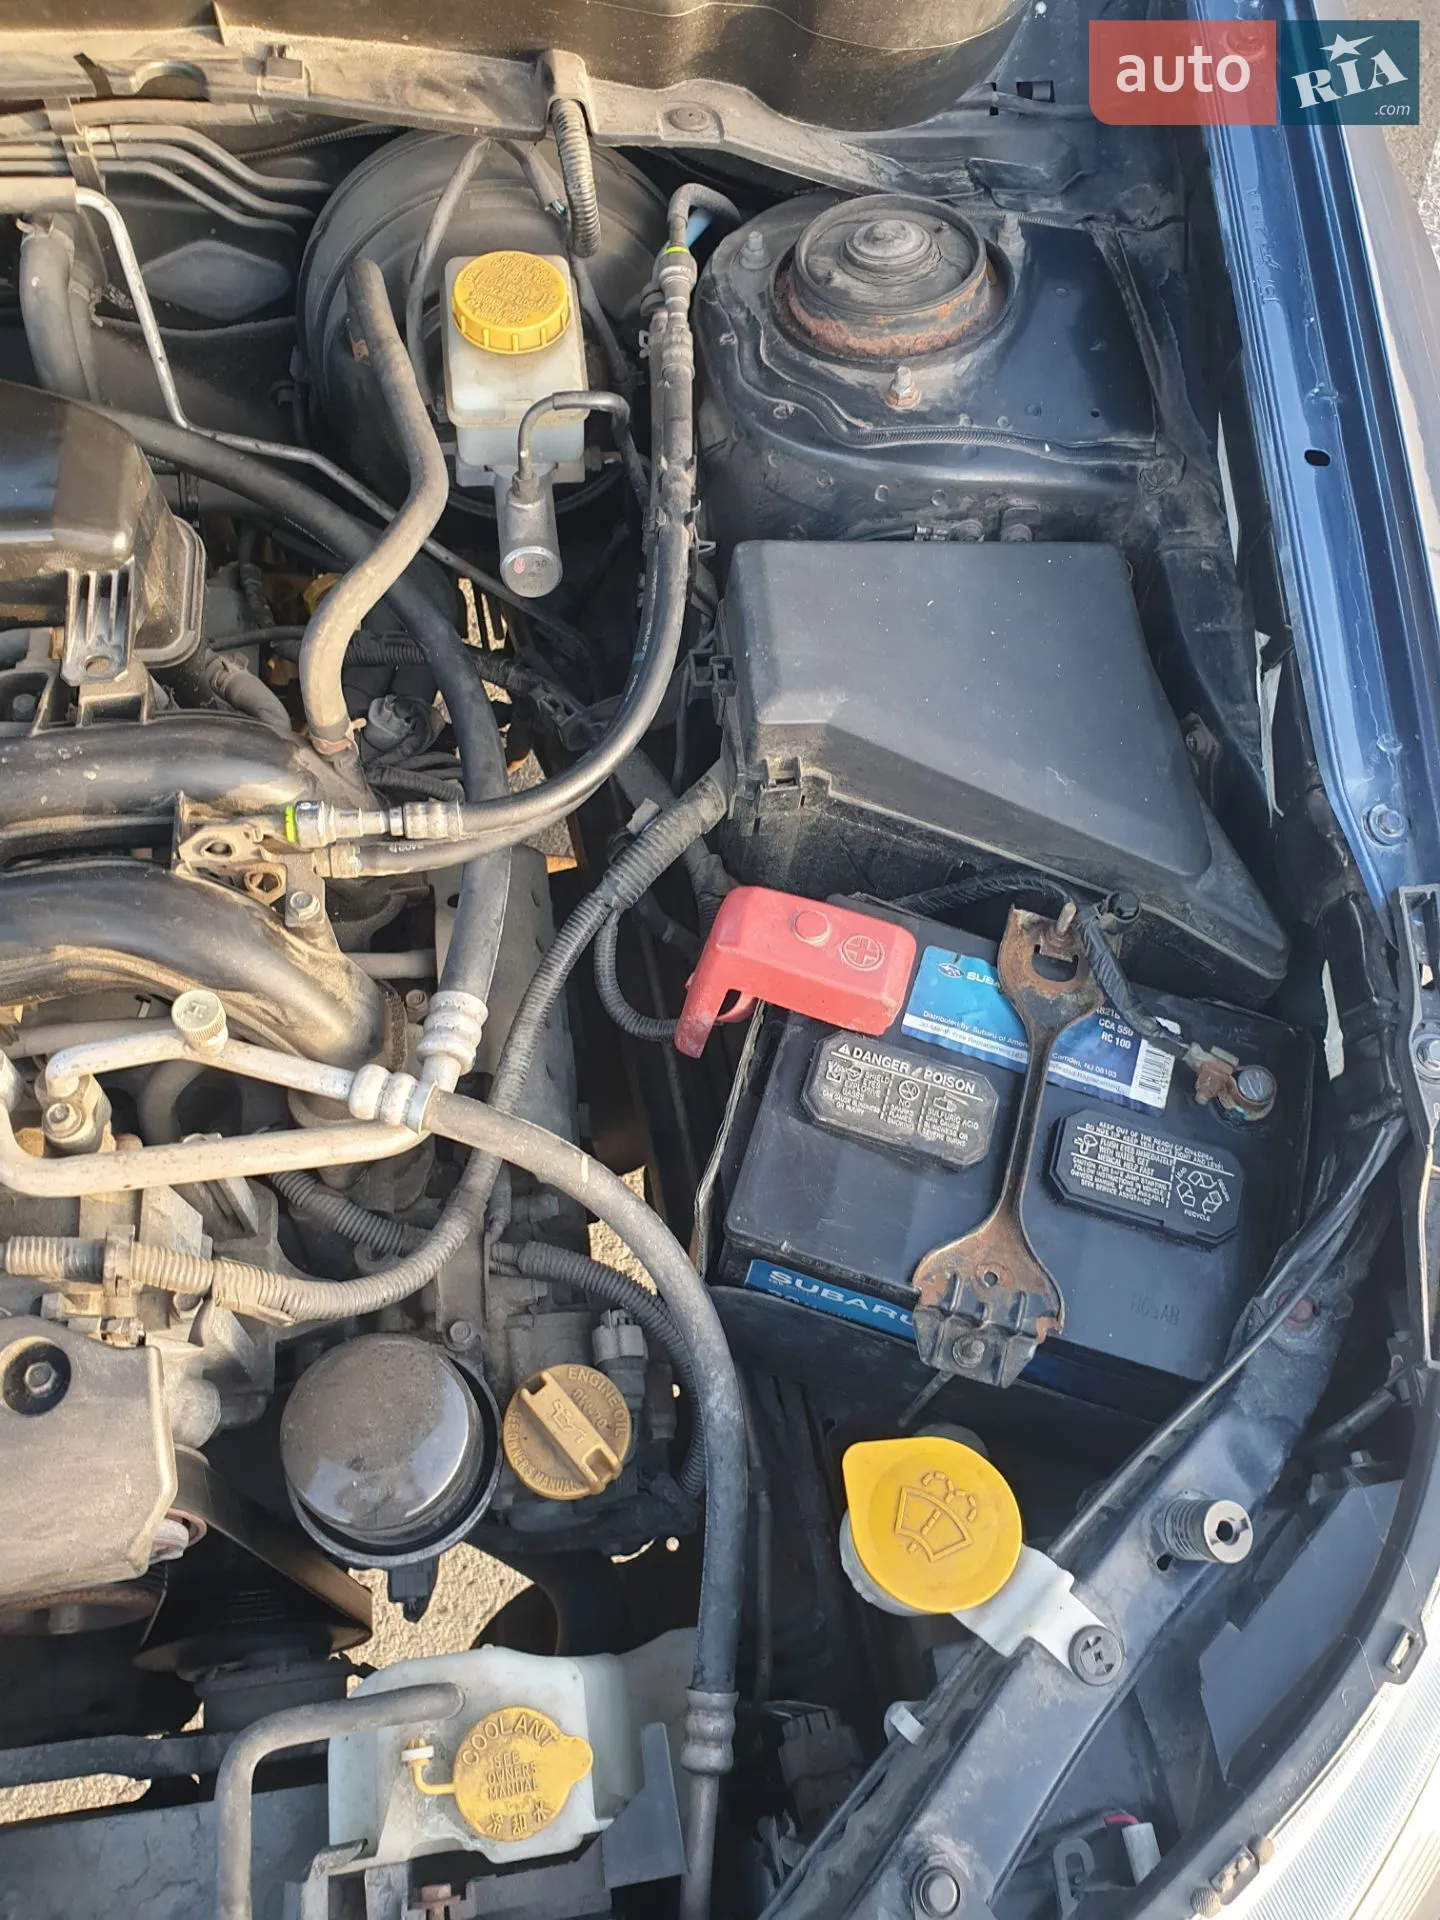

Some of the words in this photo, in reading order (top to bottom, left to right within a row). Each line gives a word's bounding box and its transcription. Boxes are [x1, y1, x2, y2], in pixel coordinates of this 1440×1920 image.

[923, 1010, 959, 1027] Distributed
[973, 1026, 997, 1040] Subaru
[998, 1034, 1007, 1042] of
[1098, 1018, 1115, 1031] CCA
[1117, 1024, 1134, 1037] 550
[1101, 1031, 1113, 1043] RC
[1115, 1037, 1131, 1049] 100
[851, 1047, 909, 1073] DANGER
[923, 1069, 975, 1094] POISON
[864, 1071, 890, 1084] SHIELD
[1084, 1062, 1095, 1072] NJ
[1095, 1066, 1117, 1078] 08103
[843, 1081, 881, 1097] EXPLOSIVE
[862, 1078, 881, 1089] EYES
[822, 1089, 834, 1098] CAN
[841, 1088, 864, 1100] GASES
[898, 1098, 910, 1107] NO
[835, 1101, 845, 1109] OR
[889, 1104, 914, 1116] SPARKS
[886, 1117, 914, 1130] SMOKING
[888, 1111, 912, 1123] FLAMES
[925, 1115, 938, 1123] CAN
[938, 1119, 959, 1130] CAUSE
[926, 1108, 961, 1123] SULFURIC
[961, 1119, 979, 1130] ACID
[921, 1128, 944, 1140] SEVERE
[945, 1135, 966, 1147] BURNS
[923, 1121, 957, 1136] BLINDNESS
[958, 1132, 968, 1140] OR
[1095, 1127, 1109, 1135] NOT
[1122, 1135, 1138, 1144] KEEP
[1139, 1140, 1155, 1149] VENT
[1156, 1145, 1173, 1155] CAPS
[1174, 1150, 1192, 1161] TIGHT
[1192, 1156, 1206, 1165] AND
[1099, 1121, 1115, 1130] KEEP
[1115, 1126, 1129, 1135] OUT
[1140, 1134, 1152, 1142] THE
[1152, 1138, 1174, 1148] REACH
[1183, 1147, 1214, 1161] CHILDREN
[1098, 1146, 1116, 1157] WITH
[1135, 1157, 1149, 1167] GET
[1099, 1138, 1119, 1150] FLUSH
[1119, 1144, 1134, 1154] EYES
[1134, 1148, 1174, 1166] IMMEDIATELY
[1096, 1153, 1122, 1166] MEDICAL
[1122, 1160, 1138, 1171] HELP
[1138, 1165, 1155, 1176] FAST
[1072, 1163, 1096, 1175] FOLLOW
[1095, 1170, 1134, 1187] INSTRUCTIONS
[1097, 1164, 1109, 1172] FOR
[1109, 1168, 1124, 1177] SAFE
[1124, 1173, 1140, 1182] JUMP
[1140, 1177, 1167, 1190] STARTING
[1080, 1179, 1094, 1188] SEEK
[1094, 1184, 1118, 1196] SERVICE
[1124, 1185, 1136, 1194] NOT
[1184, 1208, 1211, 1223] RECYCLE
[567, 1367, 621, 1407] ENGINE
[613, 1408, 627, 1437] OIL
[507, 1408, 520, 1430] SEE
[534, 1472, 576, 1492] MANUAL
[462, 1714, 558, 1765] COOLANT
[494, 1751, 520, 1769] SEE
[487, 1760, 537, 1785] OWNERS
[488, 1778, 537, 1800] MANUAL
